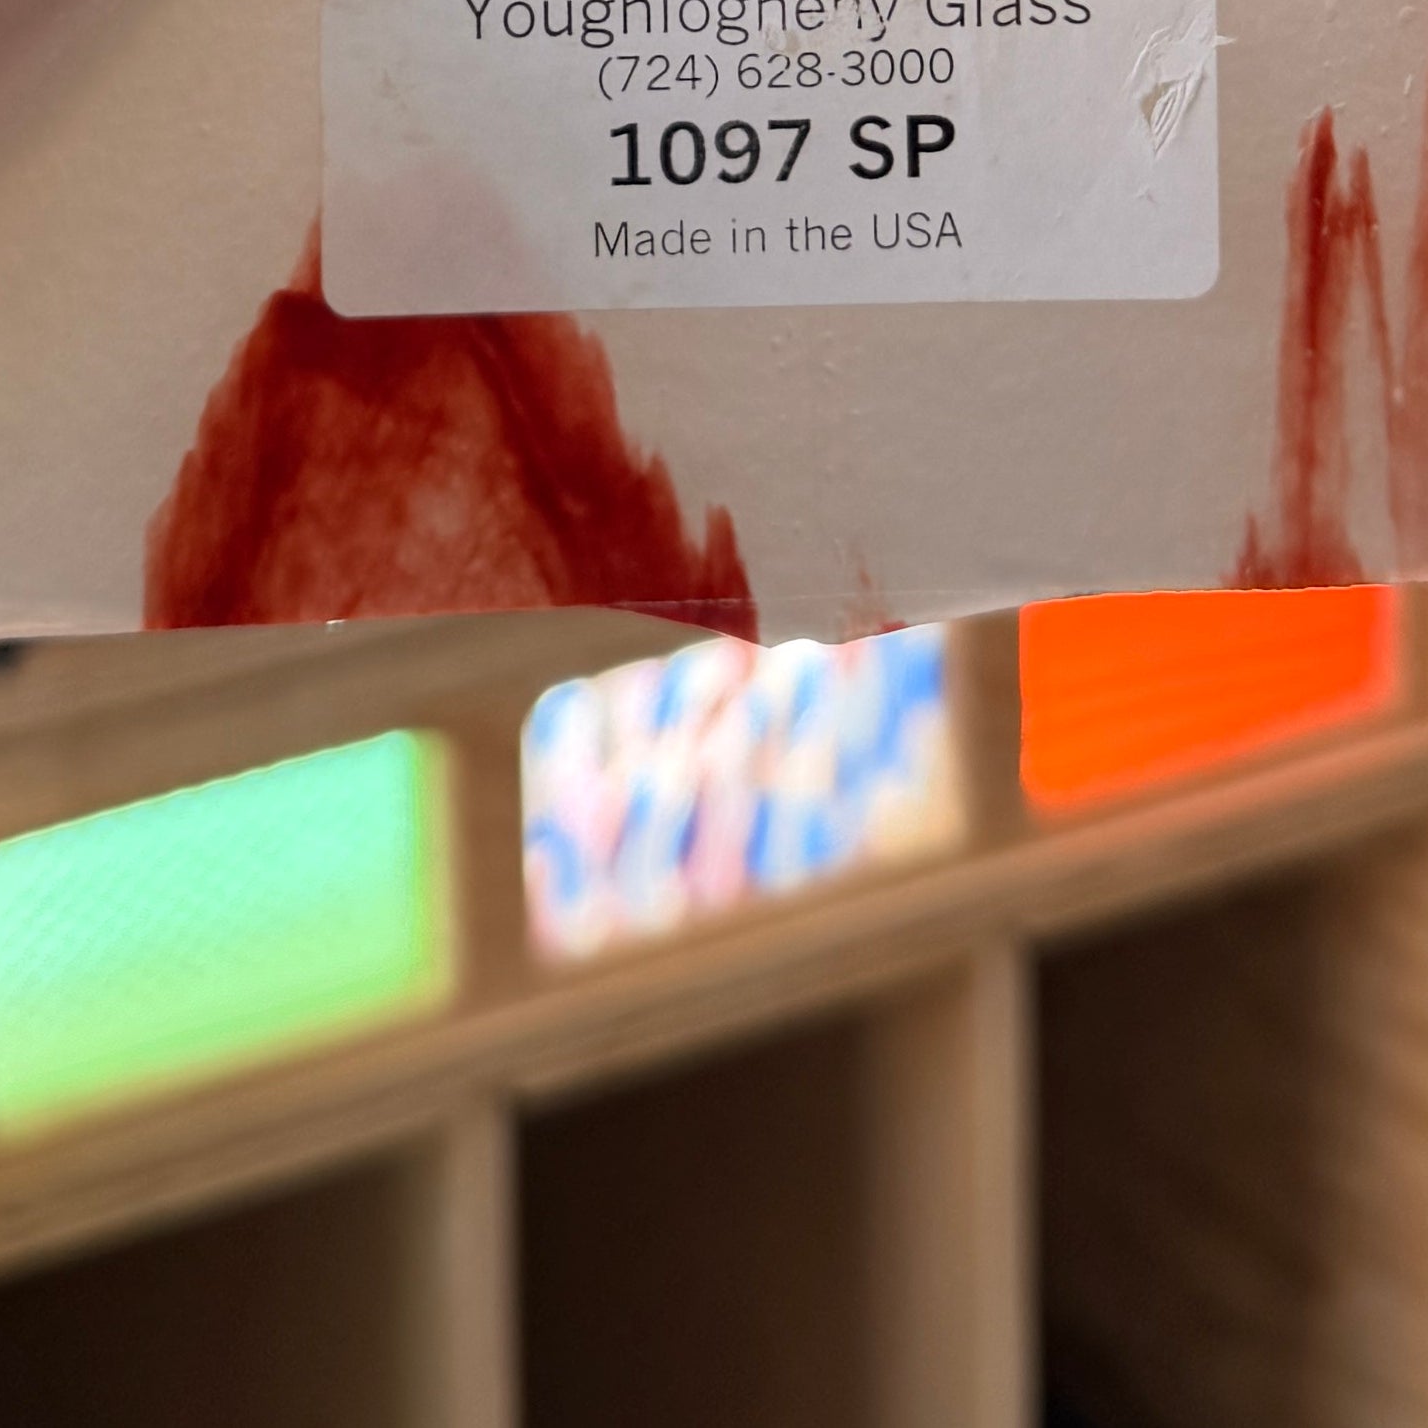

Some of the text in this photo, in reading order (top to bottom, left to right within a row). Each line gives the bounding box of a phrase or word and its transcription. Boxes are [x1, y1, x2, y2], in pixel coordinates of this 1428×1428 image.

[597, 47, 956, 101] (724) 628-3000
[608, 113, 957, 187] 1097 SP
[594, 211, 963, 258] Made in the USA
